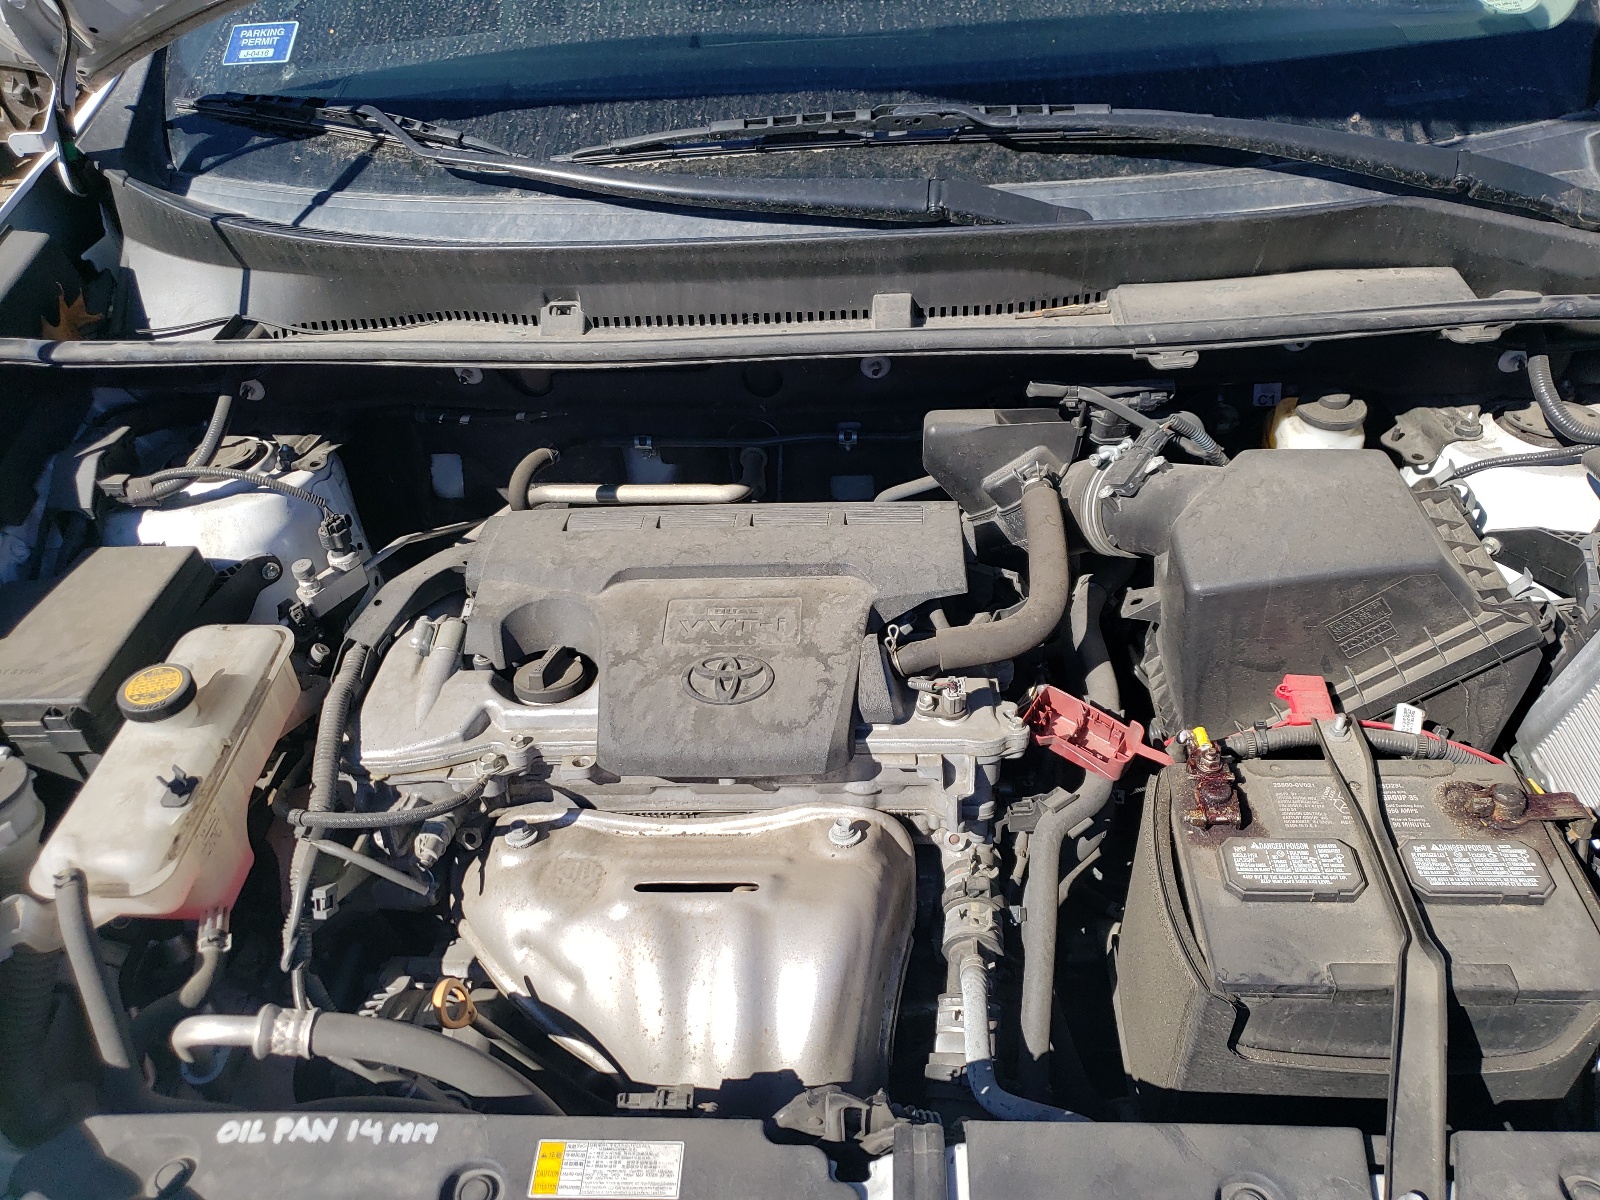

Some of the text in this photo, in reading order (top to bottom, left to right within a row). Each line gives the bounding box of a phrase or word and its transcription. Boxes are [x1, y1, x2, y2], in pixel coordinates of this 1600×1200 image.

[240, 28, 285, 38] PARKING
[241, 37, 280, 47] PERMIT
[1258, 394, 1275, 406] C1
[1258, 842, 1310, 850] DANGER/POISON
[1438, 844, 1493, 852] DANGER/POISON
[216, 1115, 439, 1145] OIL PAN 14 MM
